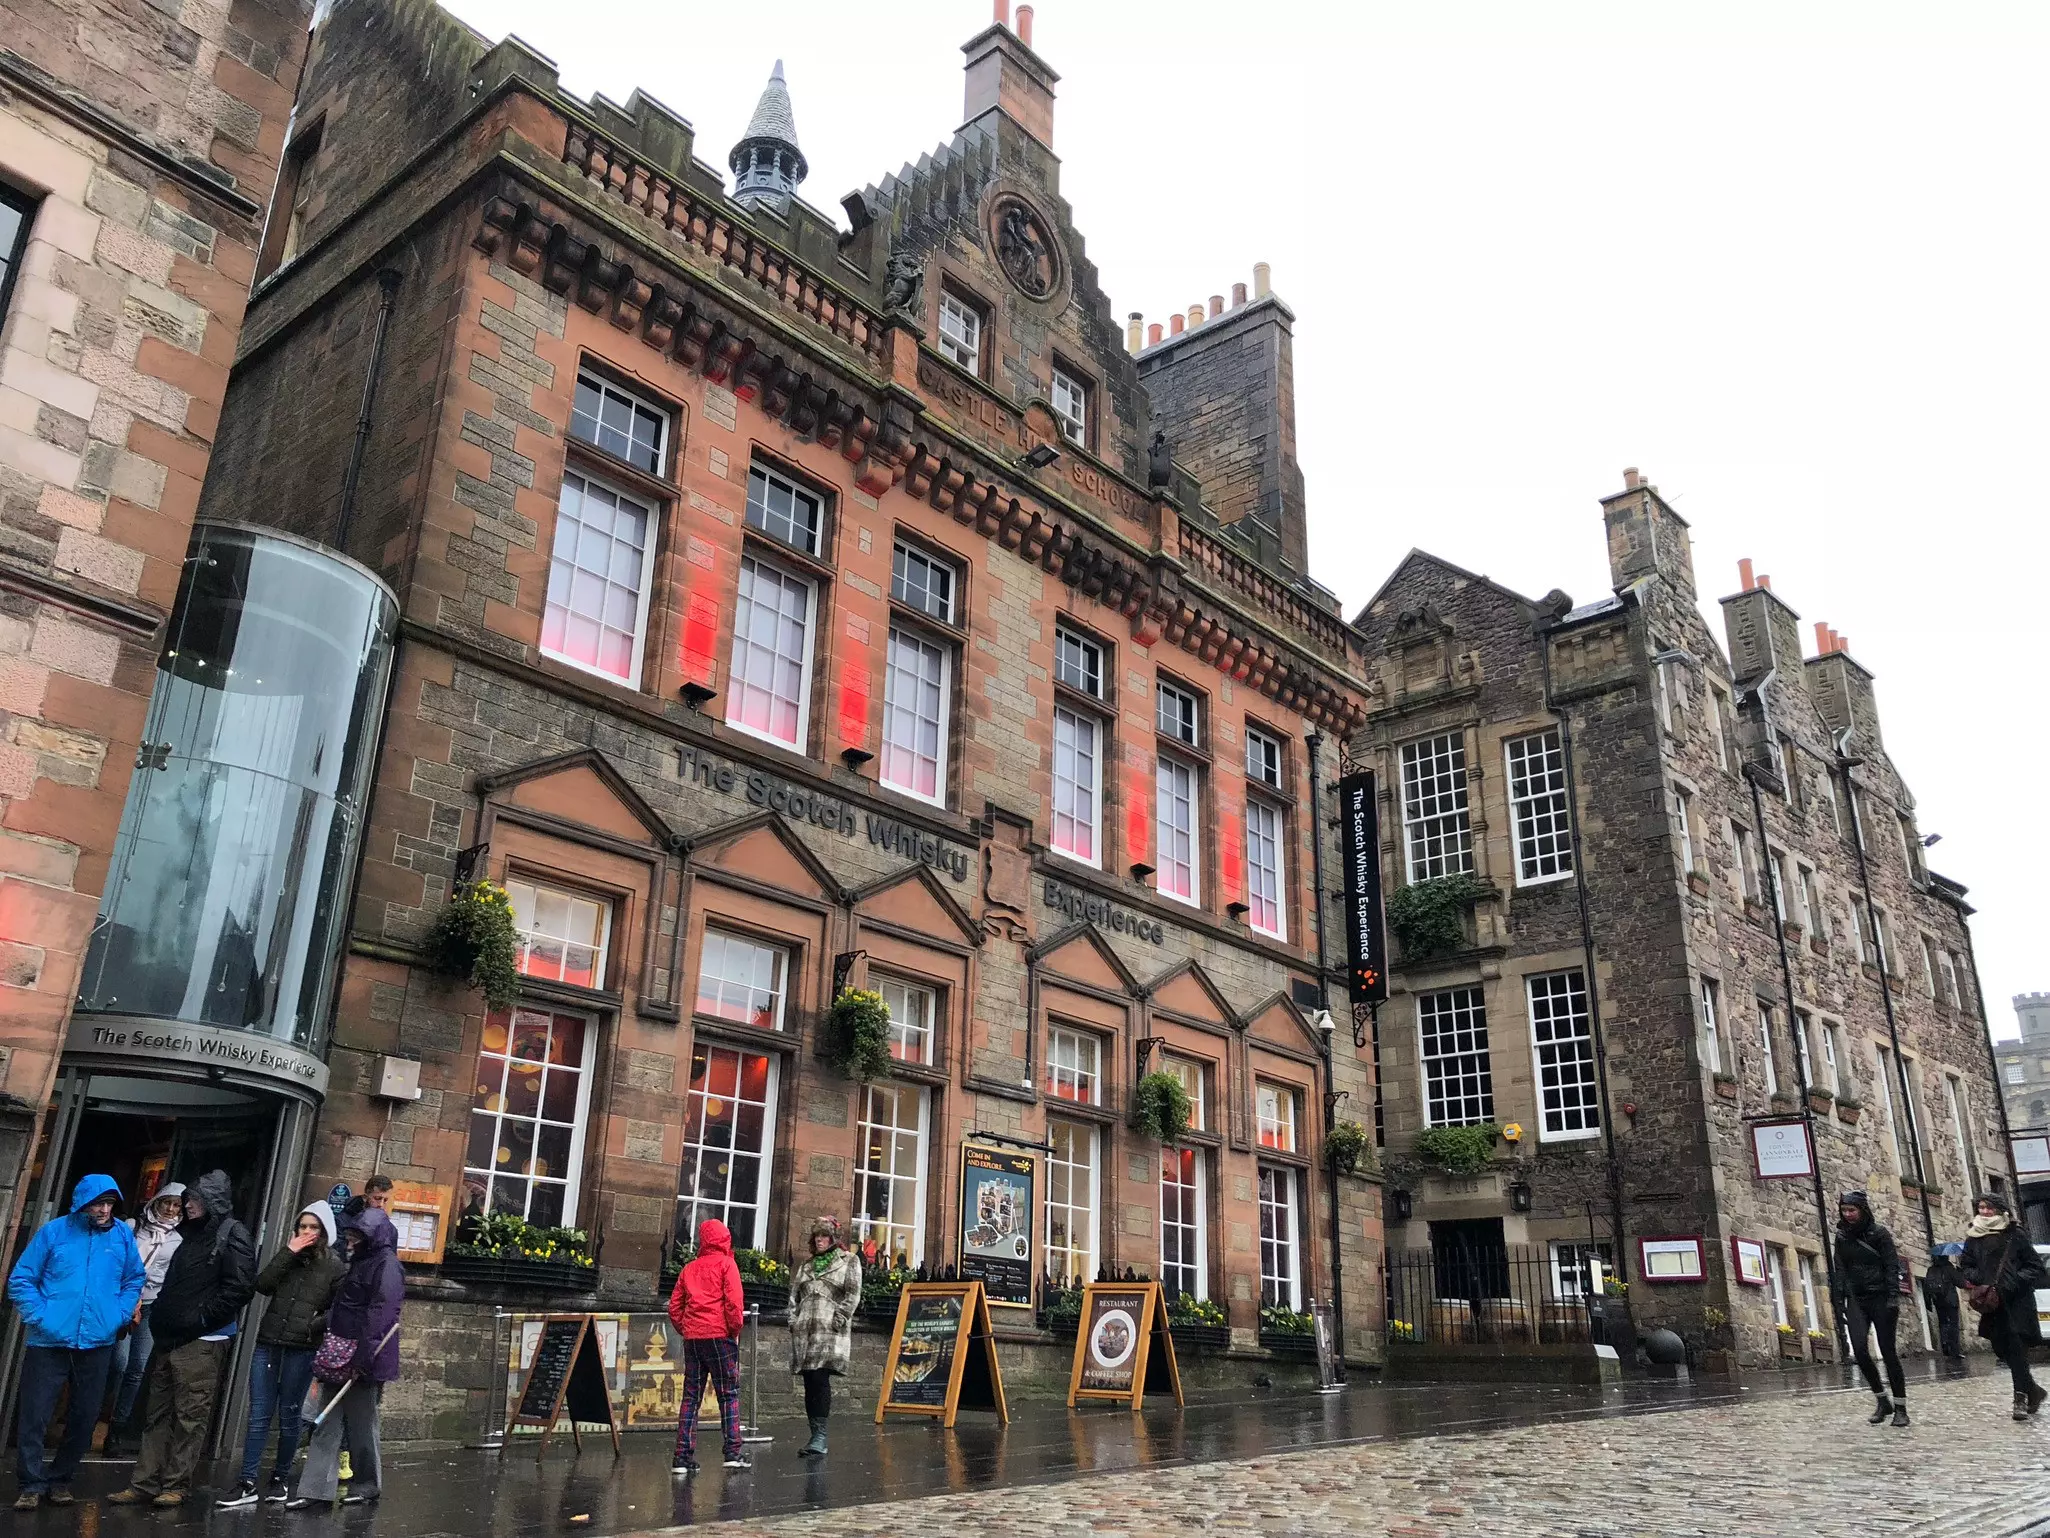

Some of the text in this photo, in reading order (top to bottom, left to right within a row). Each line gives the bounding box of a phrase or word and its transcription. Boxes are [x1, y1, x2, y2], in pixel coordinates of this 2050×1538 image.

[919, 364, 1006, 436] CASTLE
[1072, 461, 1143, 521] SCHOOL
[675, 745, 1164, 945] The Scotch Whisky Experience
[1352, 788, 1369, 960] The Scotch Whisky Experience
[92, 1027, 317, 1079] The Scotch Whisky Experience
[967, 1159, 980, 1167] AND
[1099, 1300, 1138, 1308] RESTAURANT
[1091, 1370, 1114, 1378] COFFEE
[1115, 1370, 1132, 1378] SHOP
